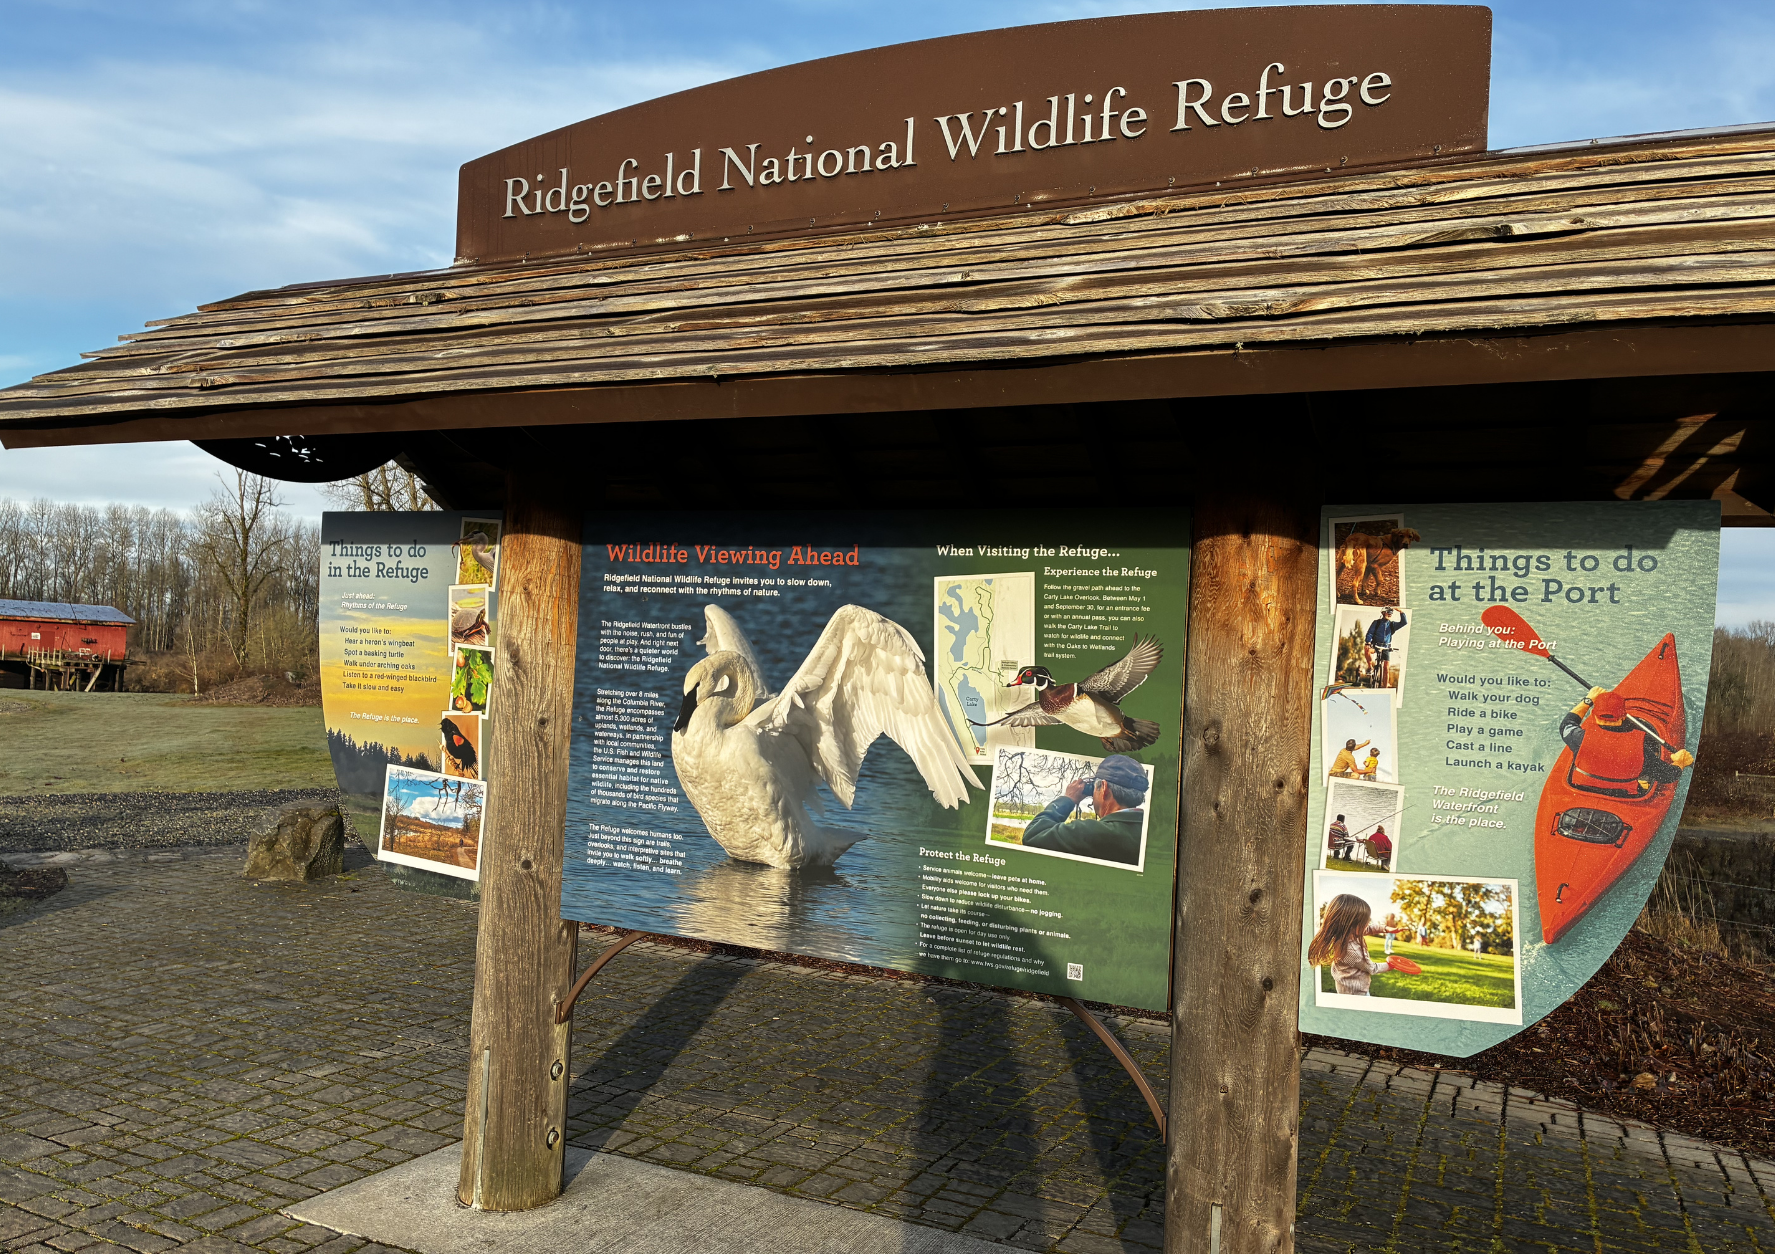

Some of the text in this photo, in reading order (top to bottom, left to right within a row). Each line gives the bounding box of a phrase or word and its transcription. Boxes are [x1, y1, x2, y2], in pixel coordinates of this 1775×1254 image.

[503, 62, 1391, 224] Ridgefield National Wildlife Refuge
[330, 539, 426, 560] Things to do
[607, 543, 859, 569] Wildlife Viewing Ahead
[938, 545, 973, 556] When
[978, 546, 1030, 559] Visiting
[1034, 546, 1055, 556] the
[1430, 545, 1658, 578] Things to do
[328, 561, 428, 583] in the Refuge
[1044, 567, 1100, 578] Experience
[1121, 567, 1157, 579] Refuge
[604, 574, 640, 583] Ridgefield
[674, 575, 702, 583] Wildlife
[704, 576, 730, 586] Refuge
[733, 577, 758, 585] invites
[760, 579, 775, 587] you
[710, 587, 741, 596] rhythms
[1429, 577, 1620, 604] at the Port
[387, 602, 408, 611] Refuge
[613, 621, 640, 629] Ridgefield
[1438, 623, 1515, 636] Behind you:
[388, 640, 415, 648] wingbeat
[1438, 637, 1557, 650] Playing at the Port
[344, 648, 358, 657] Spot
[364, 650, 387, 659] basking
[642, 656, 672, 664] Ridgefield
[377, 662, 400, 670] arching
[375, 673, 407, 682] red-winged
[409, 675, 437, 683] blackbird
[1437, 674, 1475, 684] Would
[1480, 677, 1503, 687] you
[1508, 676, 1530, 686] like
[1448, 691, 1540, 706] Walk your dog
[362, 712, 383, 721] Refuge
[1448, 707, 1475, 717] Ride
[1491, 709, 1517, 720] bike
[1447, 724, 1473, 736] Play
[1489, 728, 1523, 738] game
[1446, 740, 1474, 750] Cast
[1490, 742, 1512, 753] line
[1446, 757, 1491, 768] Launch
[1508, 761, 1544, 773] kayak
[1434, 785, 1524, 801] The Ridgefield
[1433, 799, 1500, 814] Waterfront
[1431, 815, 1506, 829] is the place.
[920, 847, 953, 859] Protect
[973, 853, 1006, 867] Refuge
